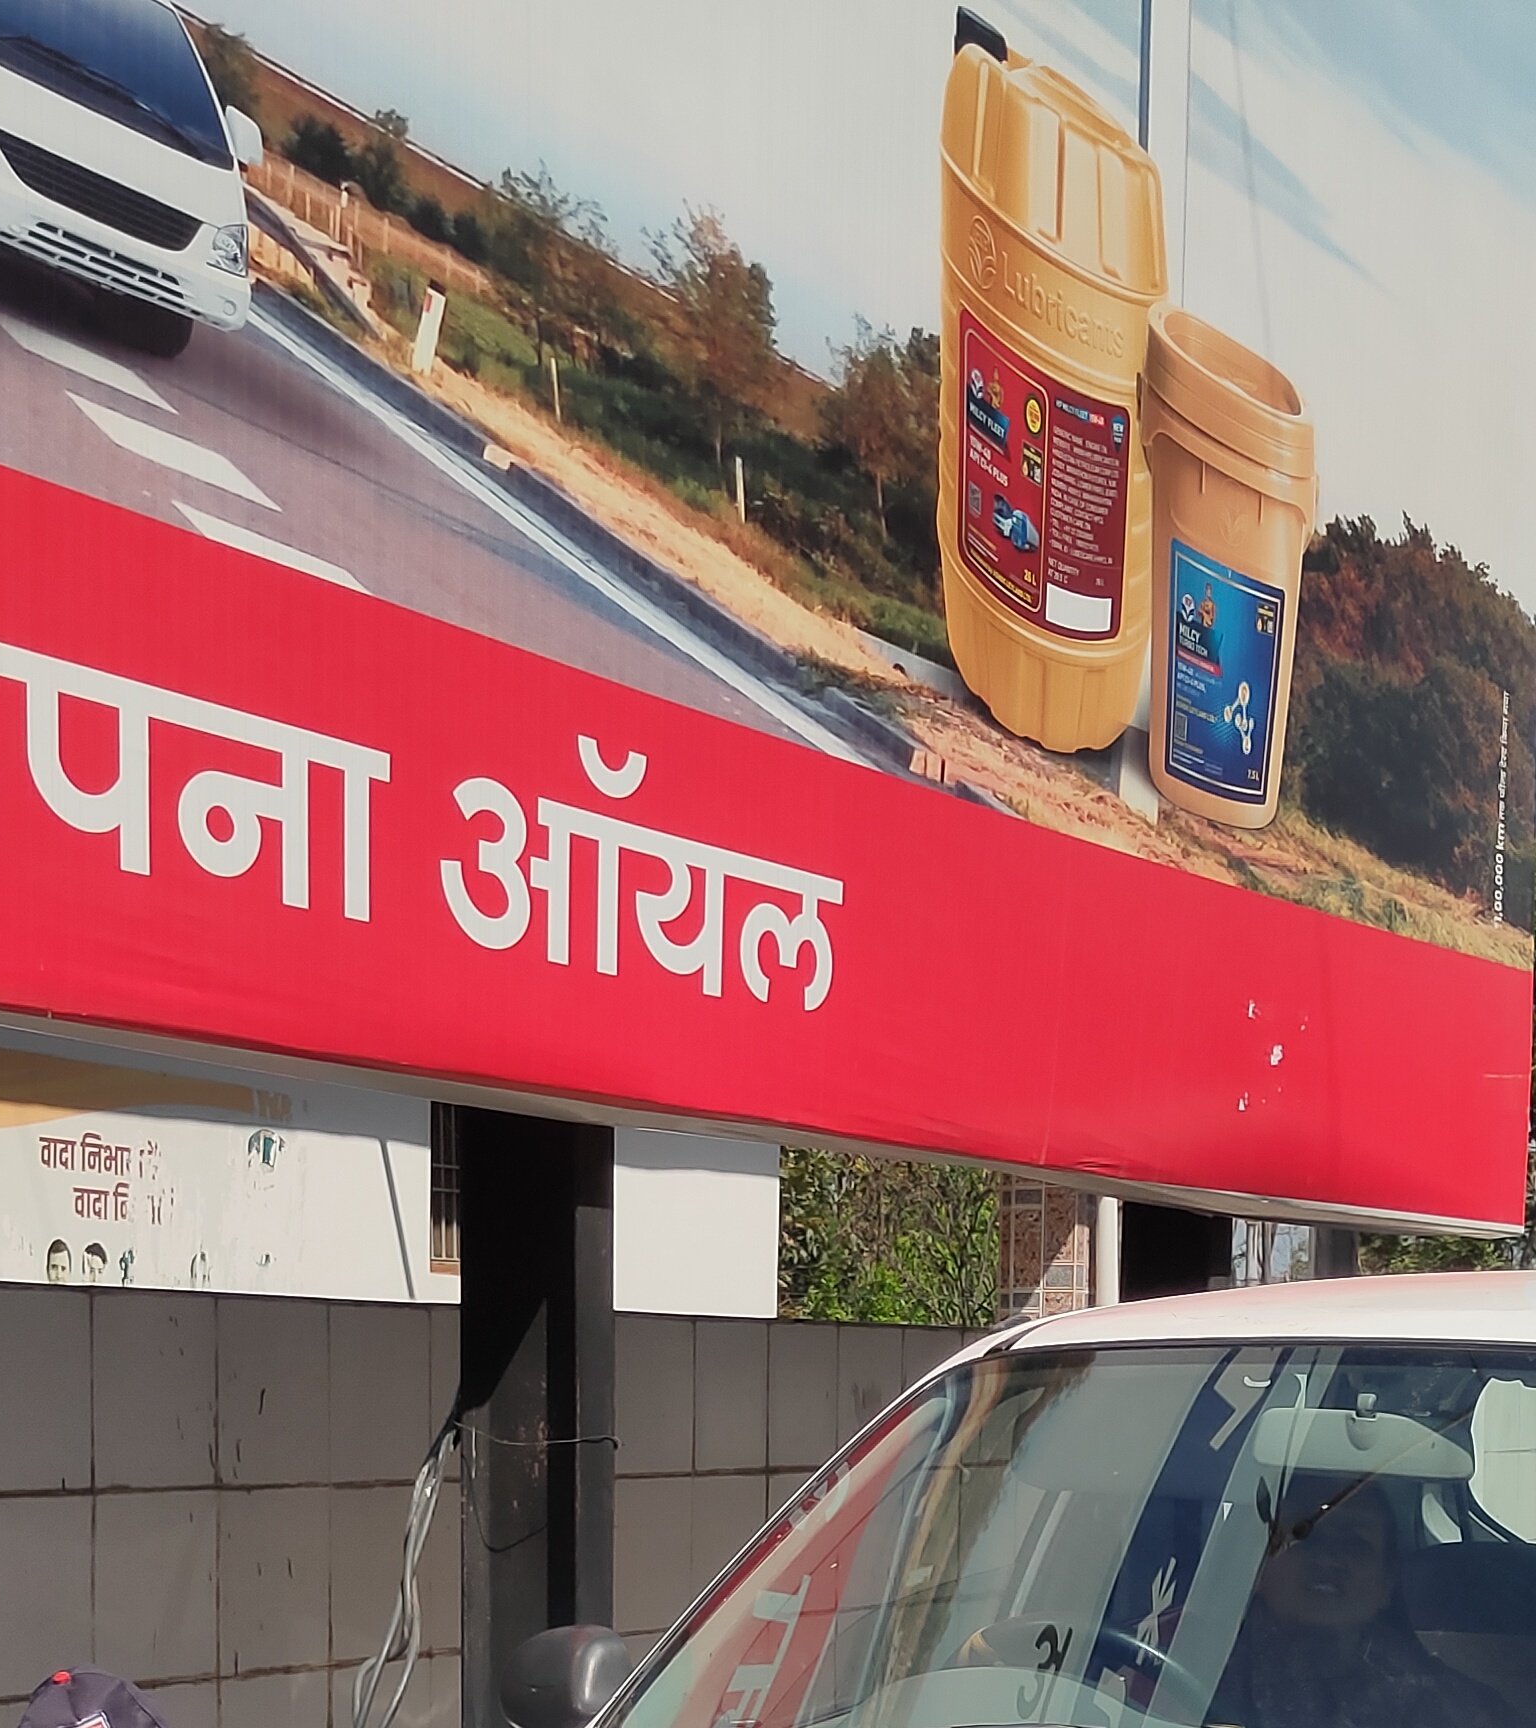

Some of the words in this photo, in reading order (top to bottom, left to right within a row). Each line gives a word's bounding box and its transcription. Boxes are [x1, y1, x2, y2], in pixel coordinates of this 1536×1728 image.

[1001, 250, 1124, 358] Lubricants
[1179, 622, 1202, 644] MILCY
[1495, 822, 1506, 850] km
[440, 735, 843, 1010] ऑयल
[38, 1136, 77, 1171] वादा
[72, 1186, 110, 1220] वादा
